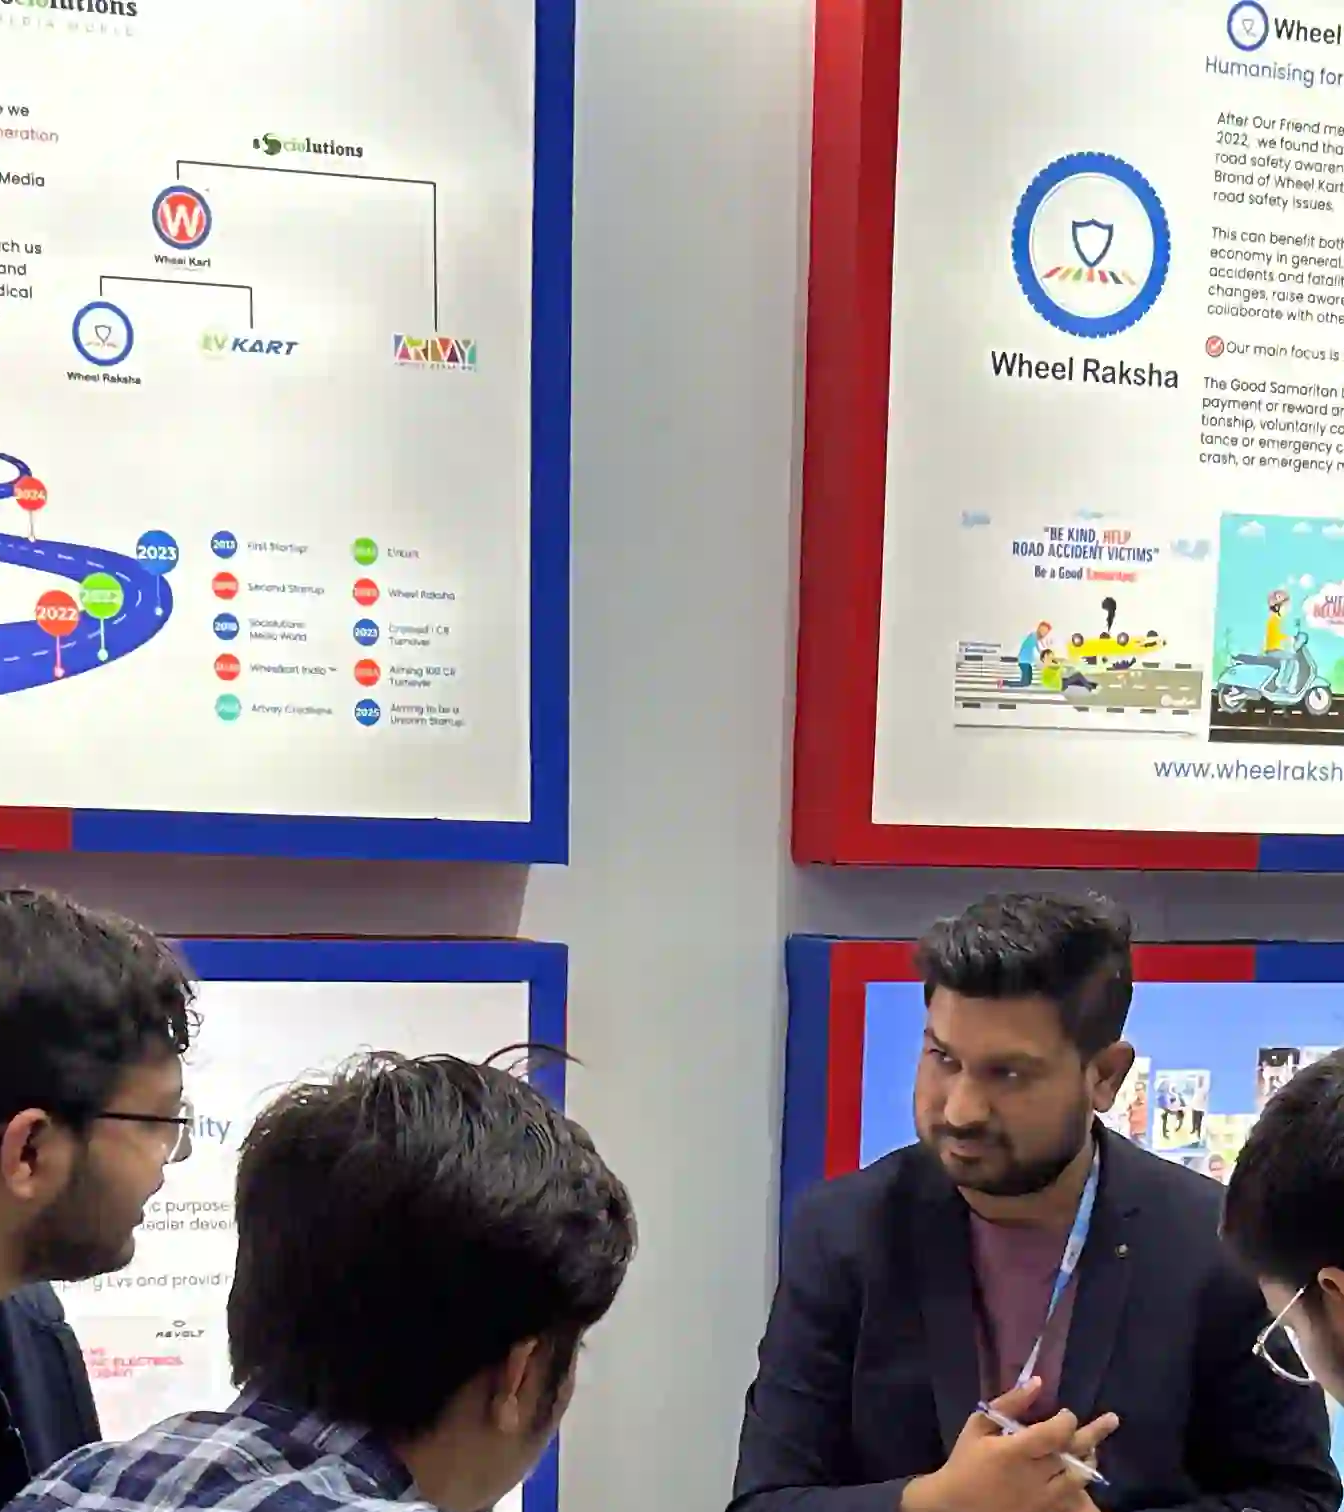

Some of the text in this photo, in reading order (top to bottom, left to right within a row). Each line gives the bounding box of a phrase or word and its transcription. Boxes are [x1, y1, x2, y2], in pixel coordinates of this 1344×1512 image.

[1274, 18, 1341, 44] Wheel
[1206, 56, 1314, 88] Humanising
[1320, 68, 1344, 85] for
[8, 106, 29, 116] we
[25, 244, 42, 254] us
[155, 254, 211, 268] Wheel Kart
[231, 338, 300, 356] KART
[1226, 341, 1250, 355] Our
[1254, 345, 1287, 356] main
[1292, 345, 1325, 360] focus
[1330, 350, 1339, 362] is
[992, 351, 1178, 388] Wheel Raksha
[67, 371, 141, 385] Wheel Raksha
[137, 546, 176, 560] 2023
[1012, 541, 1044, 556] ROAD
[1048, 544, 1105, 559] ACCIDENT
[1034, 565, 1046, 578] Be
[1059, 566, 1083, 580] Good
[36, 606, 78, 622] 2022
[136, 1274, 167, 1287] and
